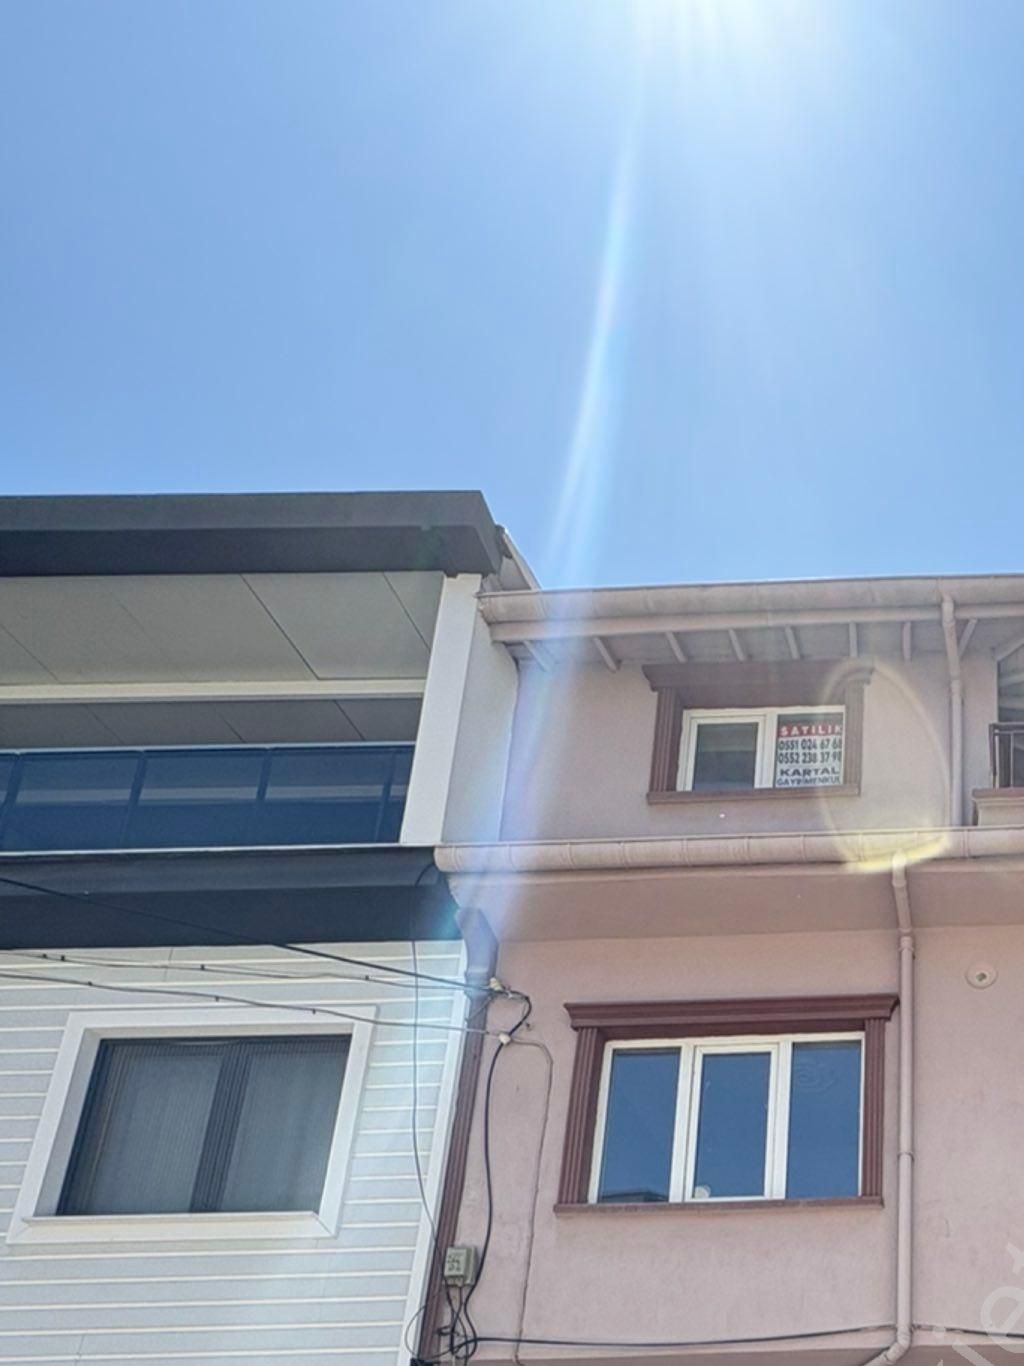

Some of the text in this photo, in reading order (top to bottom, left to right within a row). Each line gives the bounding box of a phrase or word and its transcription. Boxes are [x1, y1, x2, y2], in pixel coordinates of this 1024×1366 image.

[778, 740, 799, 751] 0551
[778, 752, 800, 764] 0552
[780, 766, 840, 776] KARTAL
